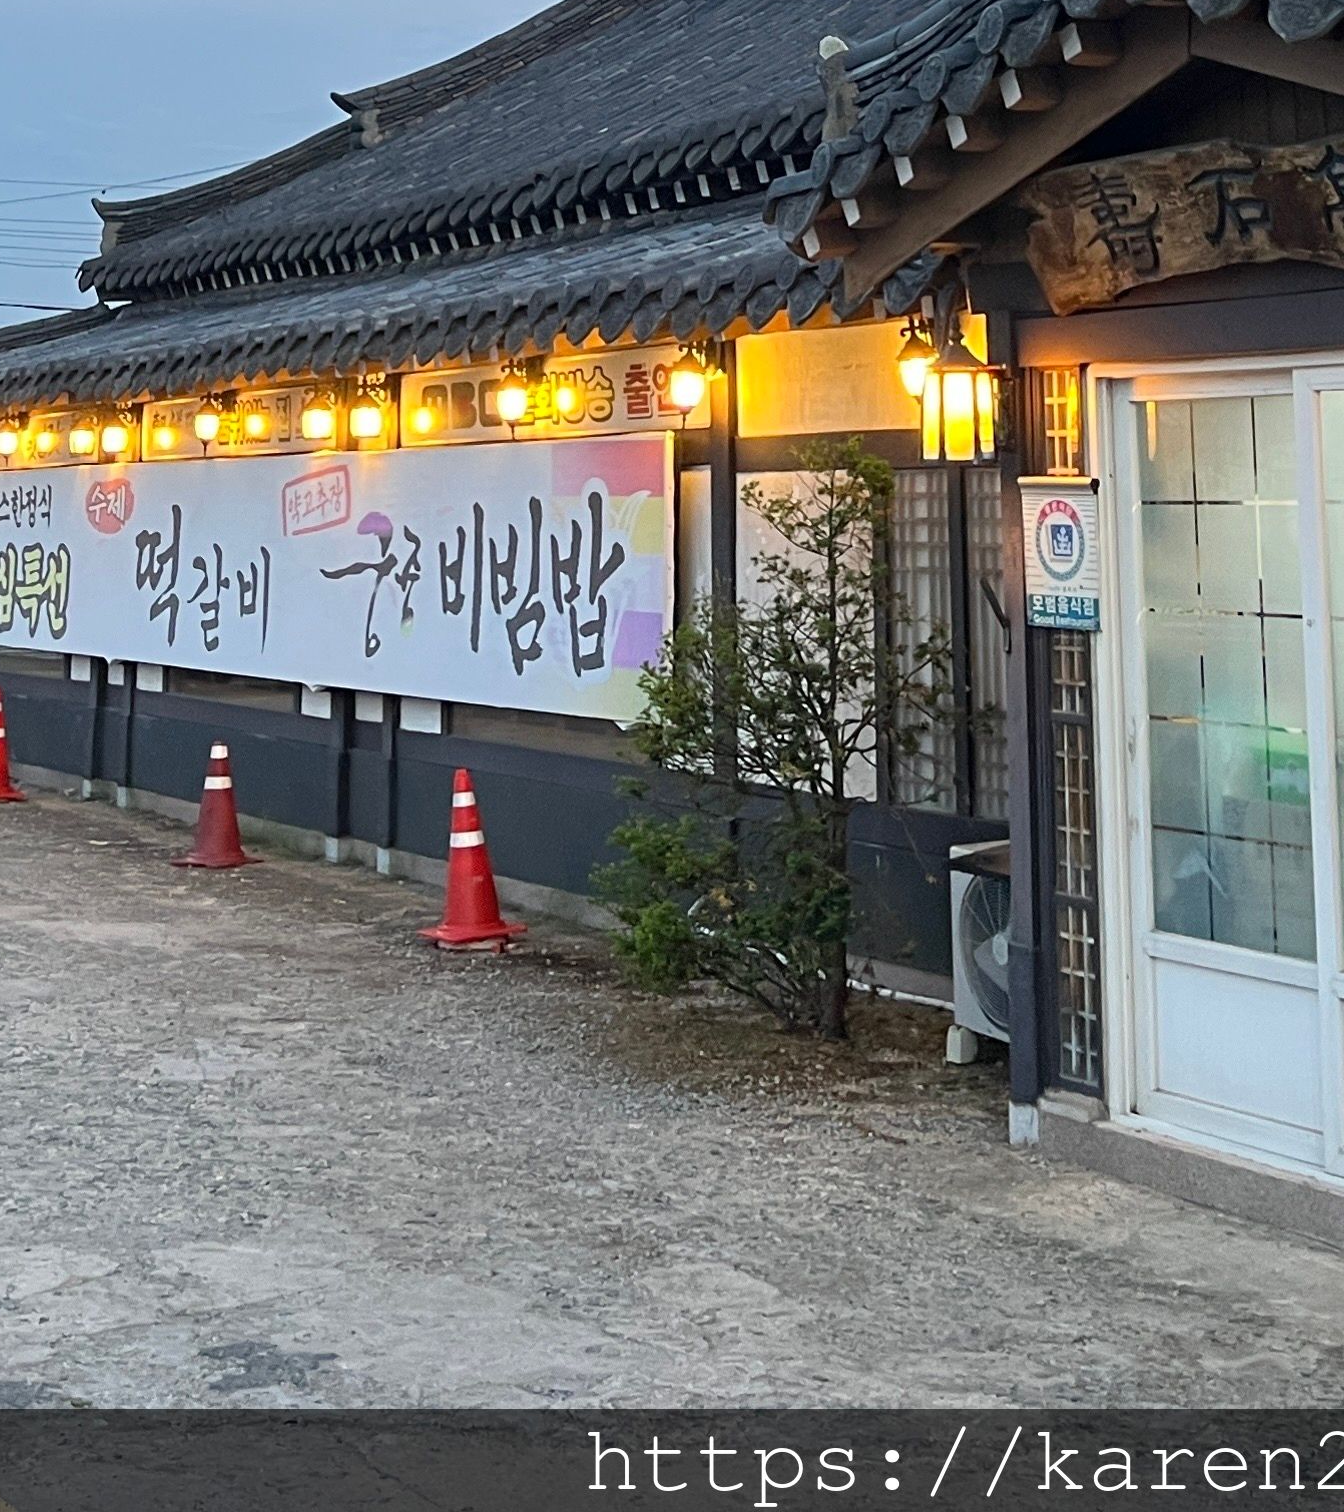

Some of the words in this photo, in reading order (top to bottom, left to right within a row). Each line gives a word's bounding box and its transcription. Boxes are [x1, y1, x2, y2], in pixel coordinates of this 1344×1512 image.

[86, 483, 127, 523] 수제
[287, 475, 344, 522] 약고추장
[136, 504, 272, 655] 떡갈비
[439, 491, 626, 678] 비빔밥
[1032, 595, 1095, 617] 모범음식점
